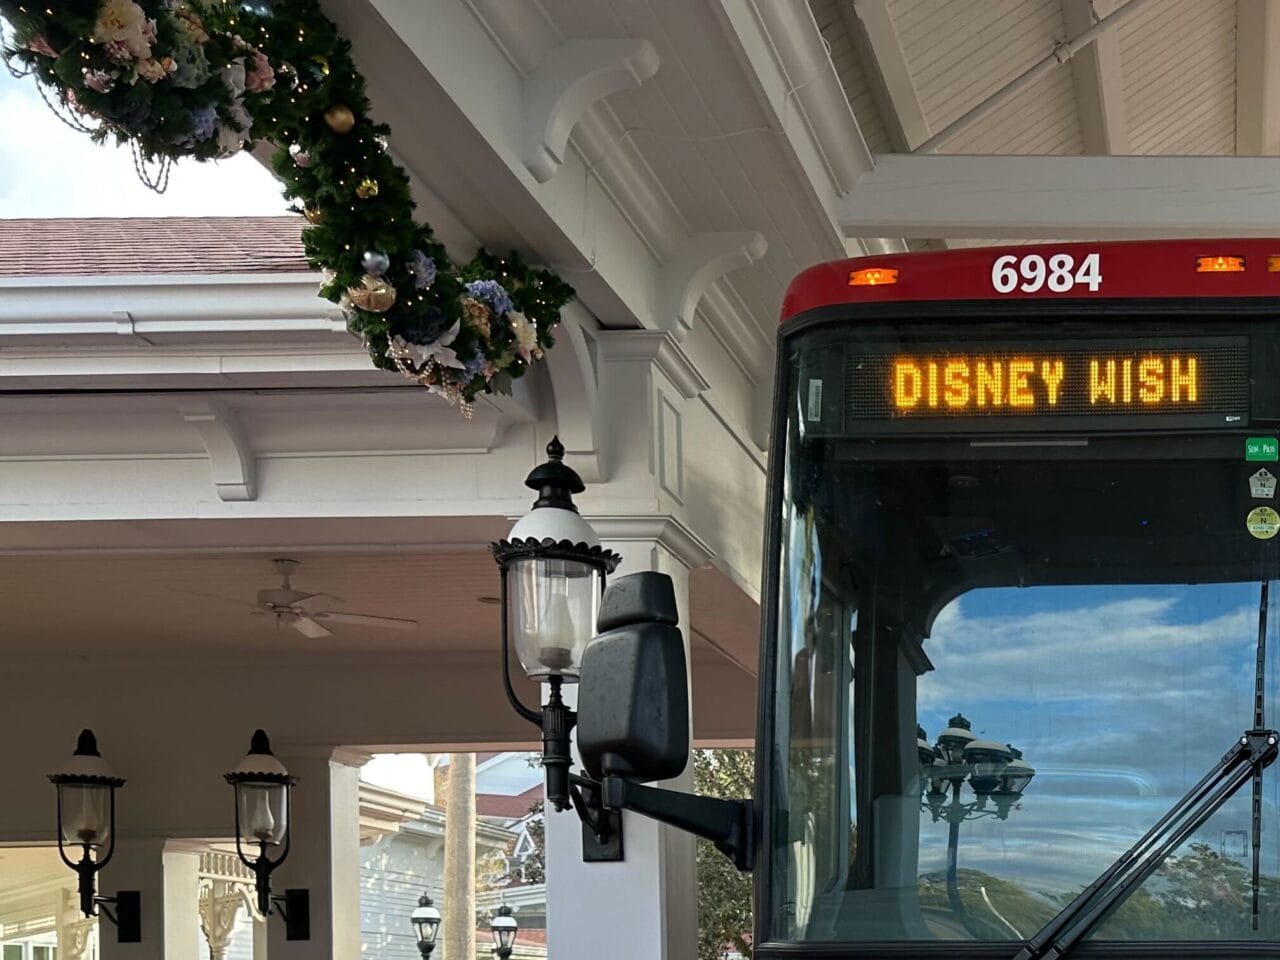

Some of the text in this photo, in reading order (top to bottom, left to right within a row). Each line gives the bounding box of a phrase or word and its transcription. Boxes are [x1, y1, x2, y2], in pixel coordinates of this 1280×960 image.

[991, 253, 1103, 293] 6984
[895, 356, 1198, 408] DISNEY WISH
